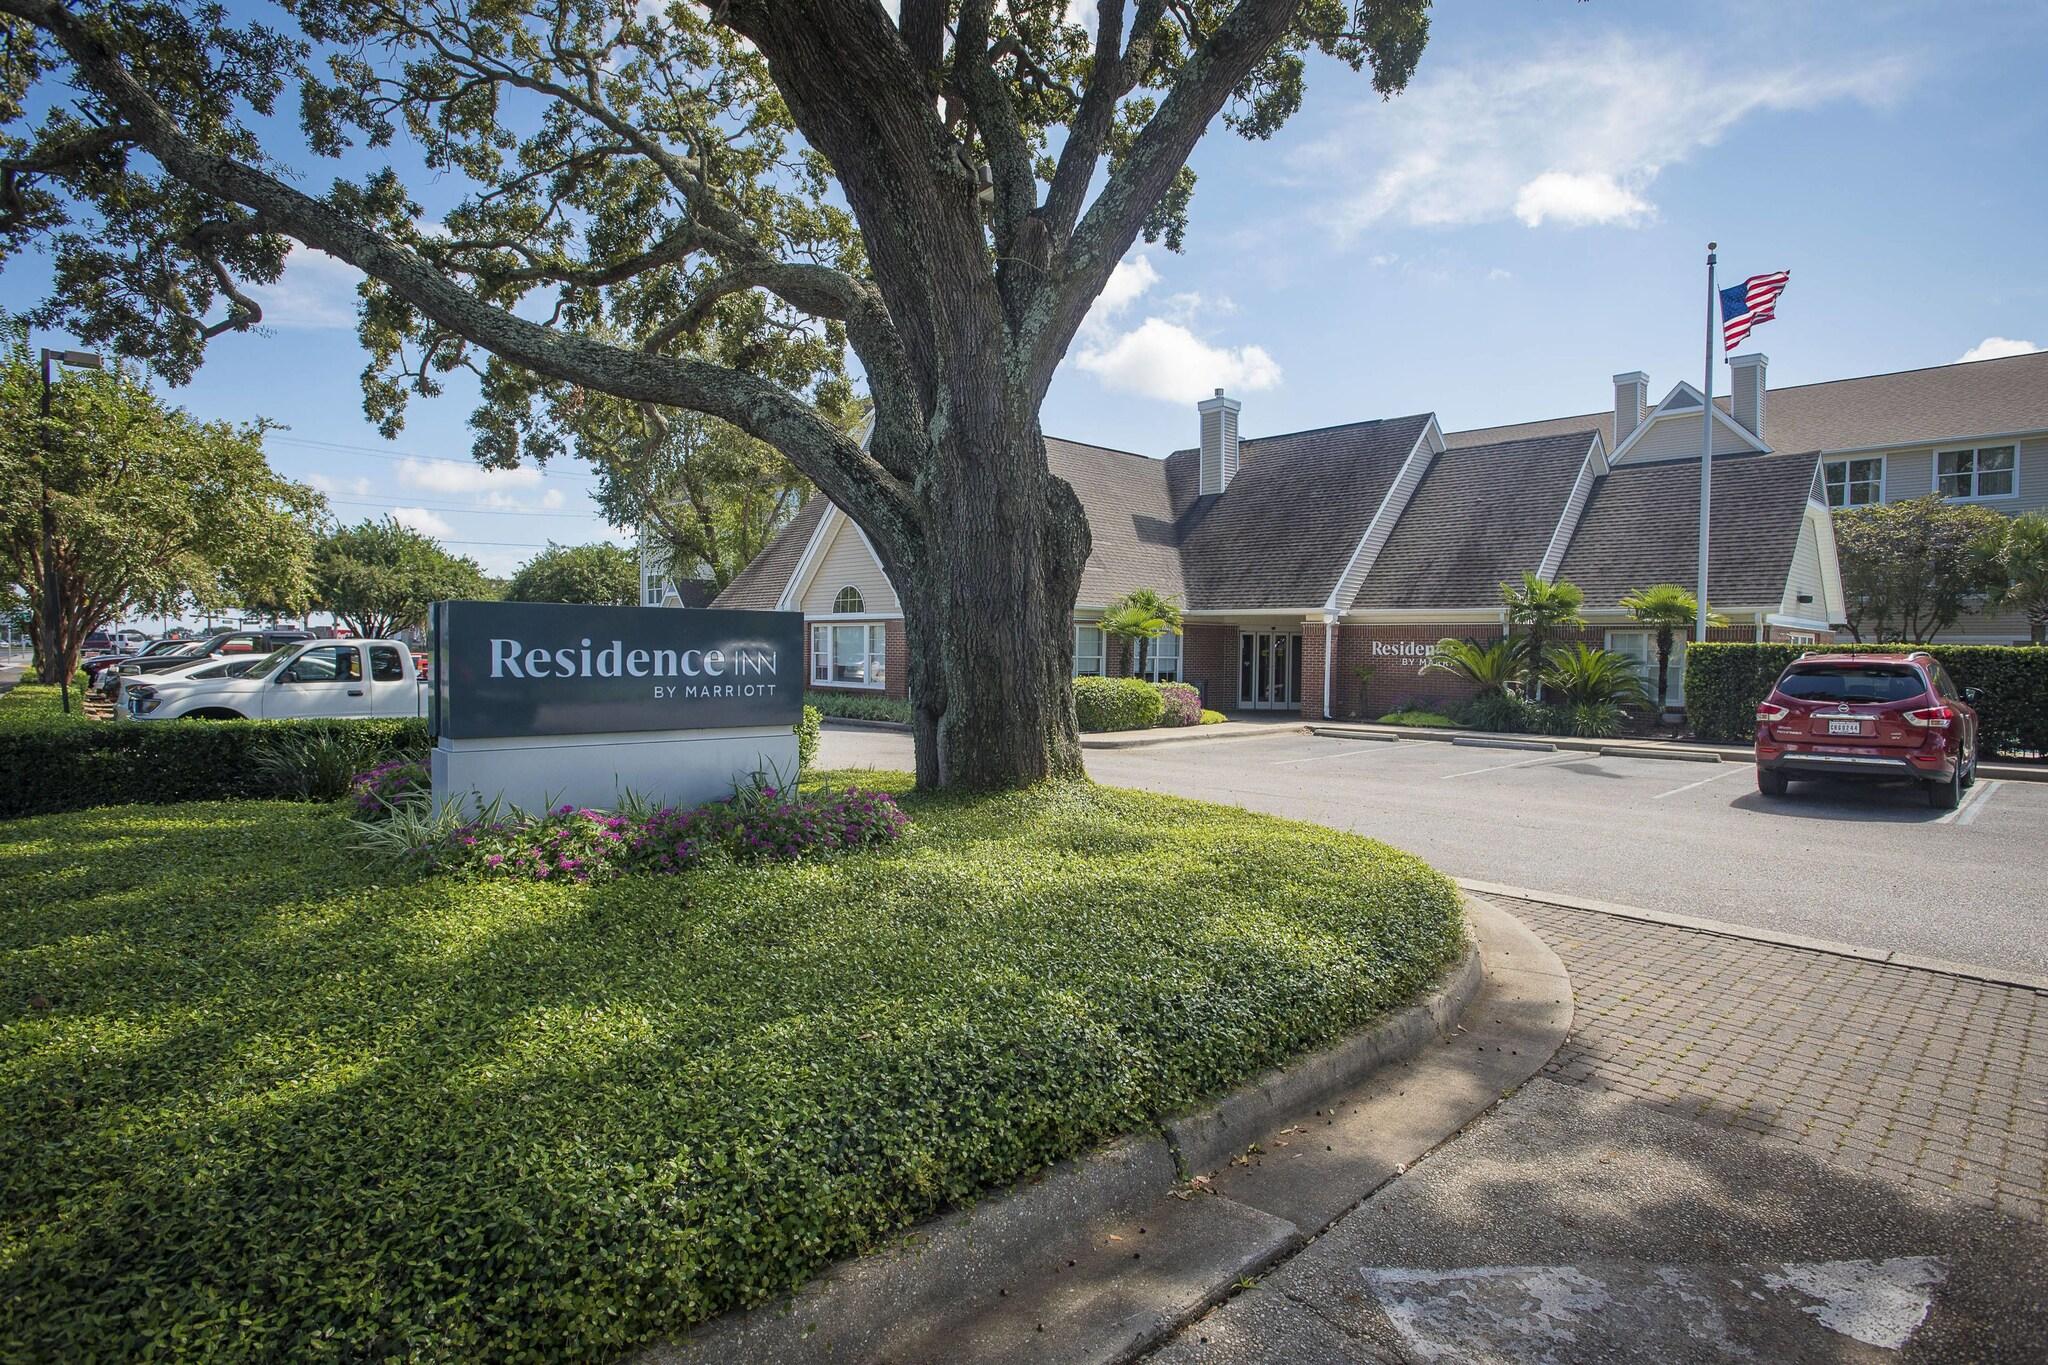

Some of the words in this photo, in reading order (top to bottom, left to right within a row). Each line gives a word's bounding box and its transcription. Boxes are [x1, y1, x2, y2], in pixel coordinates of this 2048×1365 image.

[1372, 641, 1445, 656] Residen
[489, 638, 725, 678] Residence
[735, 650, 776, 676] INN
[1401, 658, 1415, 666] BY
[654, 685, 677, 698] BY
[685, 684, 777, 698] MARRIOTT
